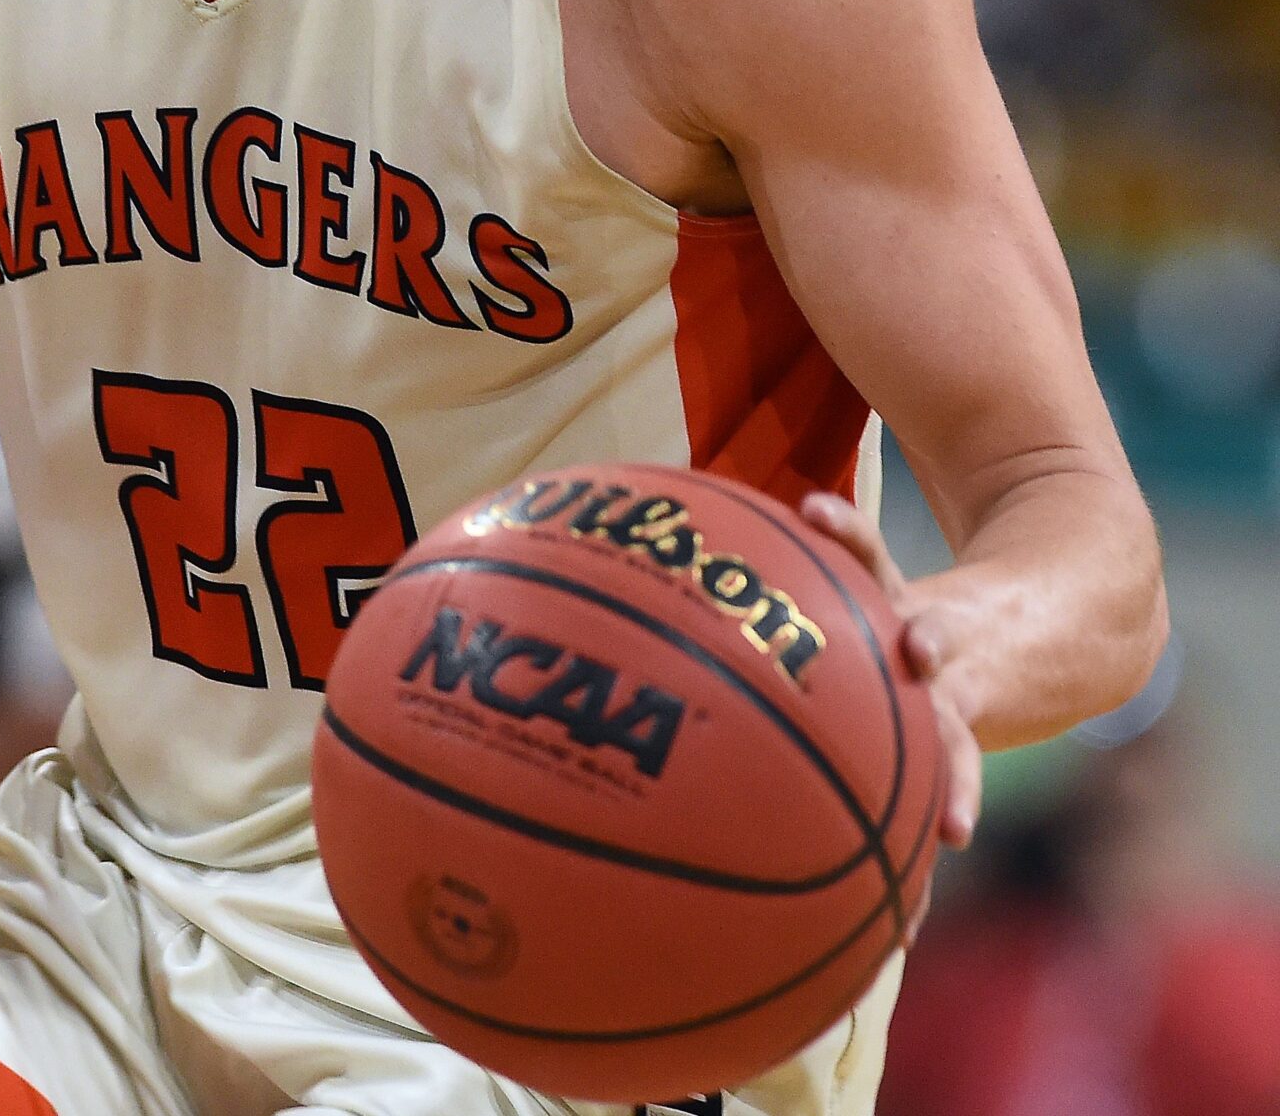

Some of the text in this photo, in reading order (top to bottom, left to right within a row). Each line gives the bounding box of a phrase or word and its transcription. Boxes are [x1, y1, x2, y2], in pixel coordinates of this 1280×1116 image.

[92, 367, 419, 693] 22
[463, 480, 828, 695] Wilson
[398, 608, 686, 779] NCAA
